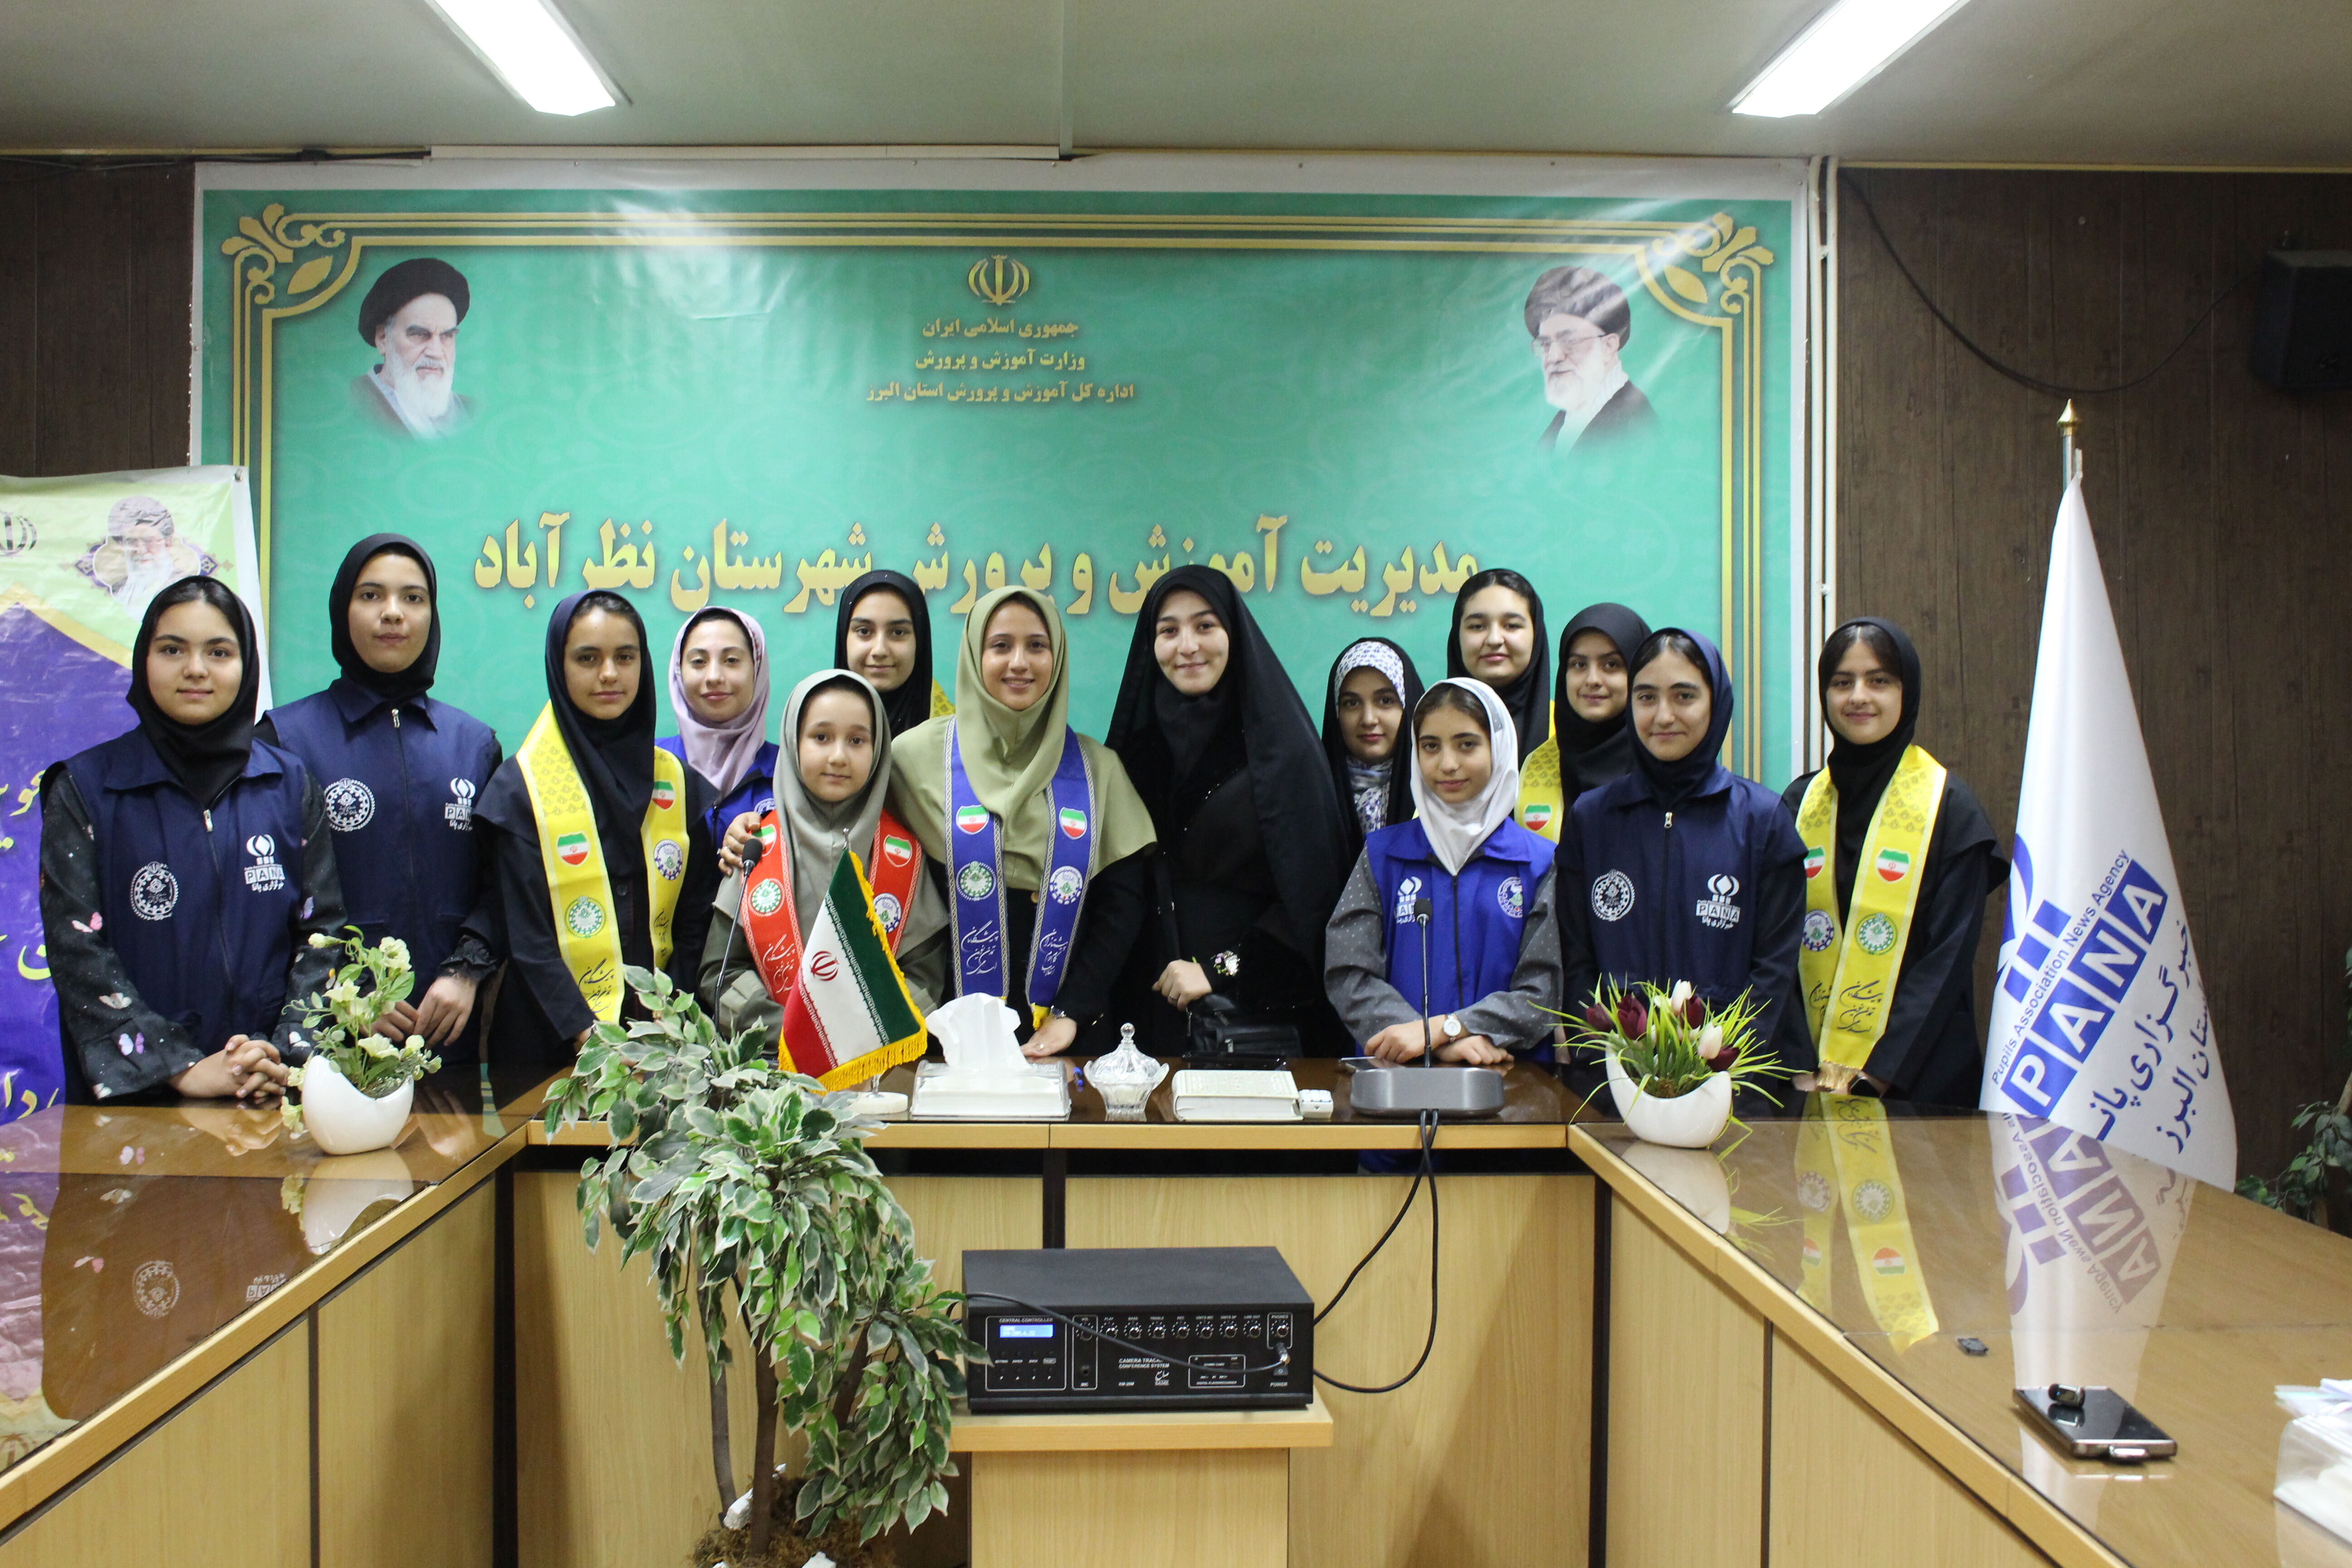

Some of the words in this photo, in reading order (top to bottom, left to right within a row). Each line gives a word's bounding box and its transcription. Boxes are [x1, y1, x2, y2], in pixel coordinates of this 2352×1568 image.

[922, 318, 960, 338] ایران
[963, 318, 1014, 338] اسلامی
[1019, 321, 1079, 338] جمهوری
[915, 349, 966, 371] پرورش
[970, 355, 977, 370] و
[981, 348, 1036, 370] آموزش
[1039, 351, 1085, 370] وزارت
[866, 381, 900, 402] البرز
[903, 382, 944, 402] استان
[947, 382, 998, 403] پرورش
[1002, 387, 1010, 402] و
[1014, 380, 1068, 402] آموزش
[1071, 382, 1094, 402] کل
[1098, 383, 1134, 402] اداره
[474, 511, 571, 609] آباد
[670, 518, 872, 614] شهرستان
[1065, 552, 1093, 614] و
[1301, 540, 1479, 617] مدیریت
[1696, 903, 1741, 923] PANA
[1991, 1036, 2018, 1085] Pupils
[2013, 948, 2067, 1036] Association
[2063, 908, 2097, 955] News
[2091, 848, 2130, 907] Agency
[2005, 871, 2165, 1114] PANA
[2156, 1066, 2198, 1155] البرز
